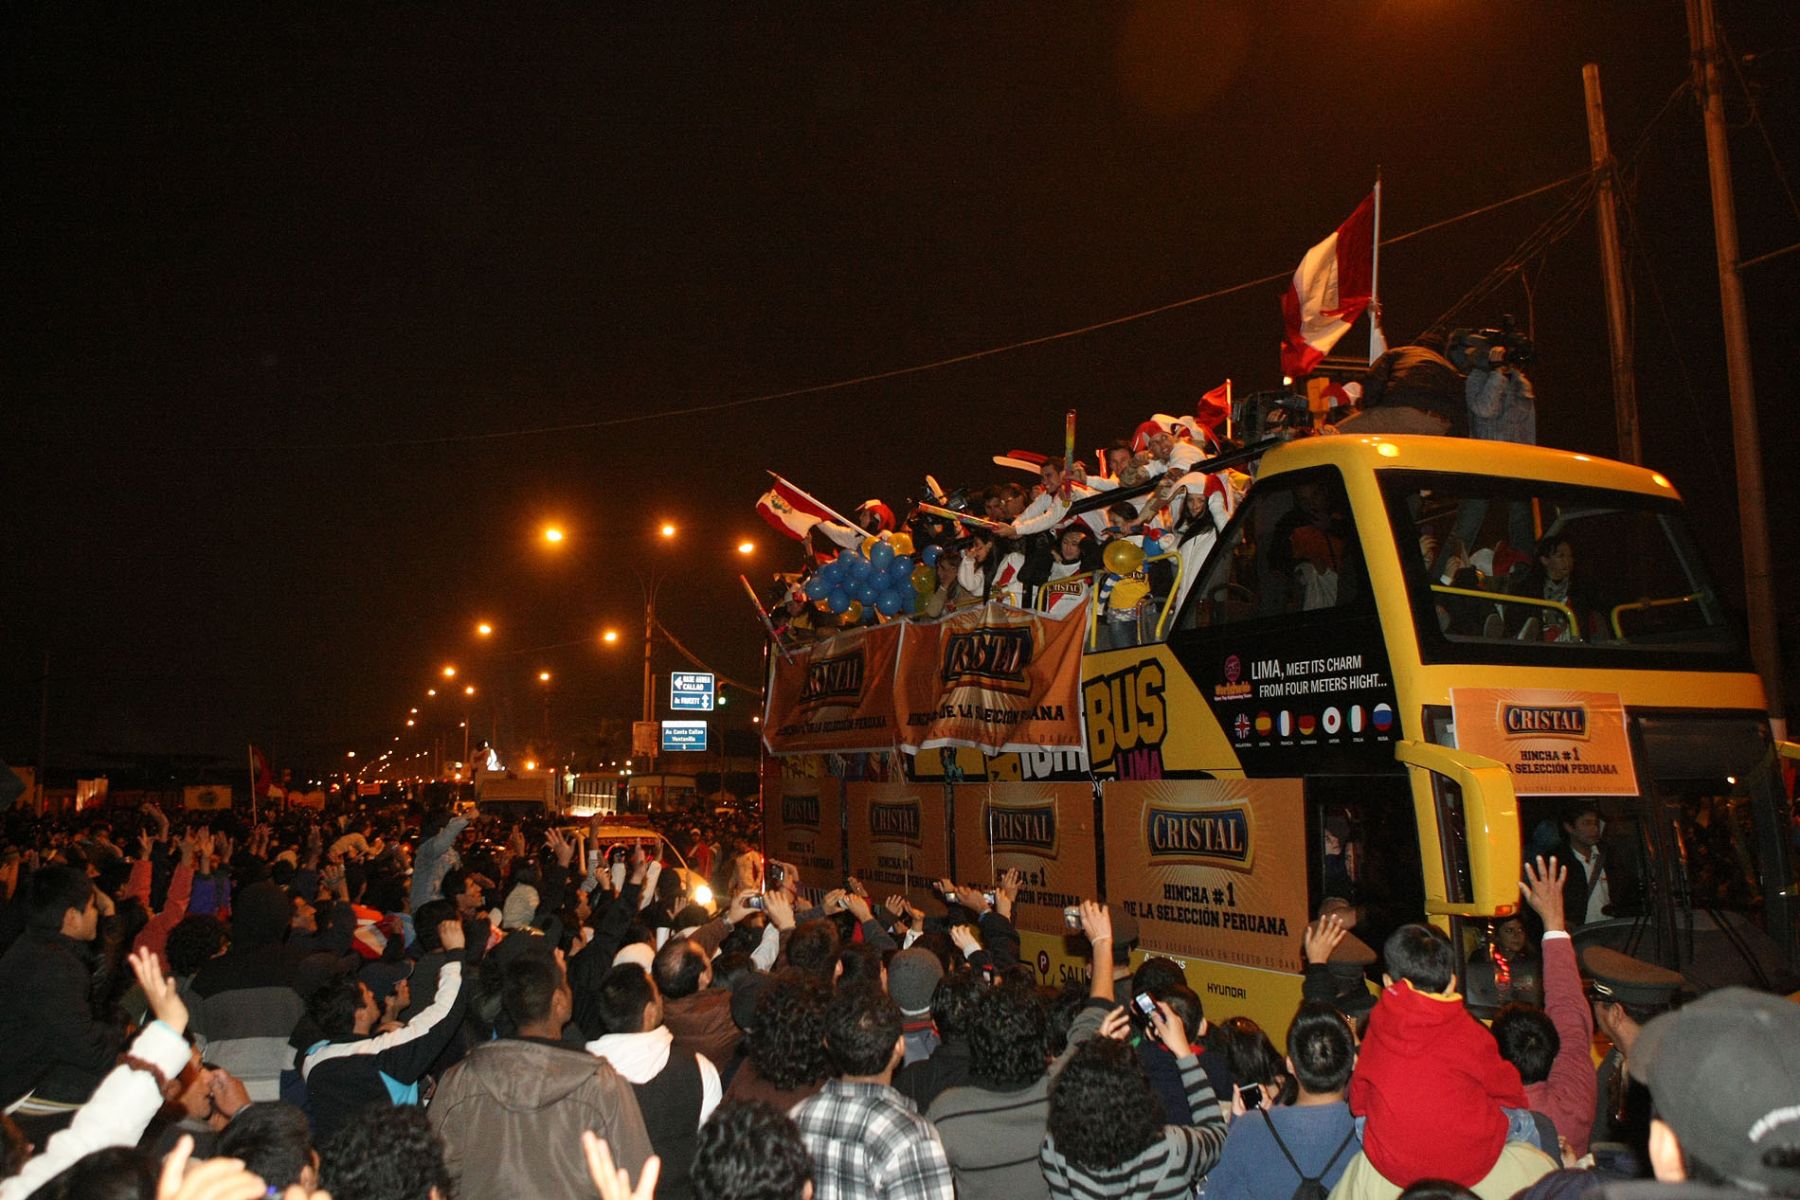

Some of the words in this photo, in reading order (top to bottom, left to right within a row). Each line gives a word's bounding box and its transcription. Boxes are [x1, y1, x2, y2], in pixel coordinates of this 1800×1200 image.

[1251, 658, 1285, 680] LIMA,
[1286, 660, 1310, 676] MEET
[1311, 658, 1326, 674] ITS
[1326, 654, 1362, 672] CHARM
[1259, 682, 1284, 698] FROM
[1285, 680, 1310, 696] FOUR
[1310, 676, 1348, 694] METERS
[1349, 673, 1388, 690] HIGHT...
[1084, 657, 1166, 768] BUS
[1508, 708, 1582, 731] CRISTAL
[1515, 762, 1570, 774] SELECCIÓN
[1572, 764, 1618, 775] PERUANA
[1520, 750, 1560, 762] HINCHA
[872, 805, 919, 834] CRISTAL
[990, 810, 1051, 842] CRISTAL
[1153, 814, 1244, 852] CRISTAL
[1164, 884, 1210, 905] HINCHA
[1139, 904, 1154, 920] LA
[1156, 906, 1220, 929] SELECCIÓN
[1222, 912, 1289, 937] PERUANA
[1207, 982, 1247, 1000] HYUNDAI
